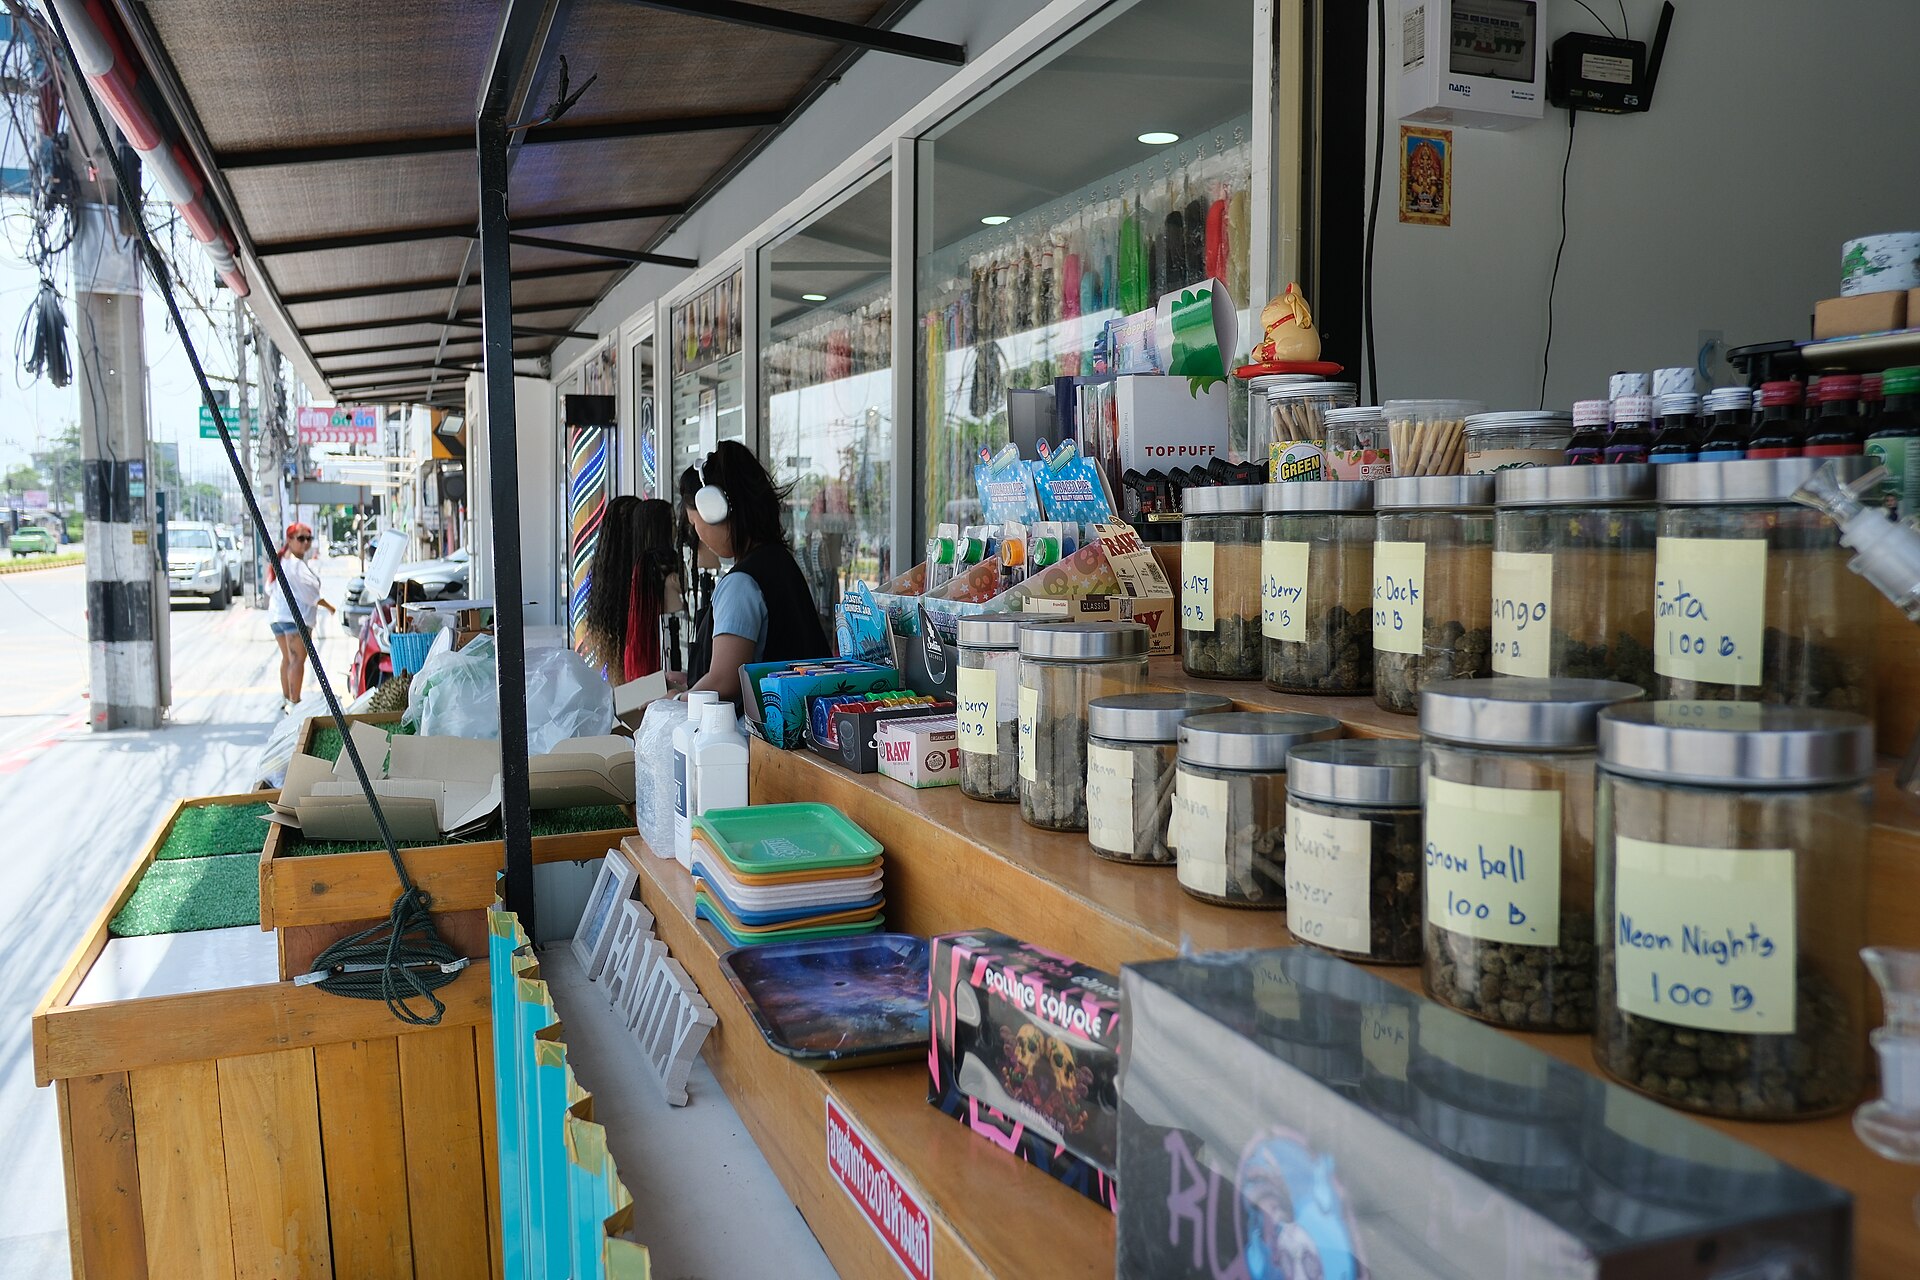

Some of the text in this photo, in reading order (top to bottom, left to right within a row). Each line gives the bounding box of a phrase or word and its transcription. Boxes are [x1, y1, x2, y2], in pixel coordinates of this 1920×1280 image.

[1145, 445, 1216, 457] TOPPUFF
[1281, 455, 1321, 480] GREEN
[1101, 531, 1140, 557] RAW
[1191, 575, 1209, 594] 47
[1270, 574, 1303, 603] Berry
[1386, 575, 1419, 605] Dock
[845, 593, 863, 604] PLASTIC
[1082, 601, 1109, 611] CLASSIC
[1656, 579, 1708, 622] Fanta
[1669, 630, 1705, 655] 100
[965, 695, 989, 719] berry
[885, 741, 911, 762] RAW
[1426, 841, 1525, 884] Snow ball
[1448, 889, 1490, 920] 100
[1299, 916, 1324, 938] 100
[1619, 910, 1776, 967] Neon Nights
[599, 897, 700, 1100] FAMILY
[1651, 971, 1713, 1008] 100
[985, 967, 1035, 1010] ROLLING
[1039, 992, 1103, 1040] CONSOLE
